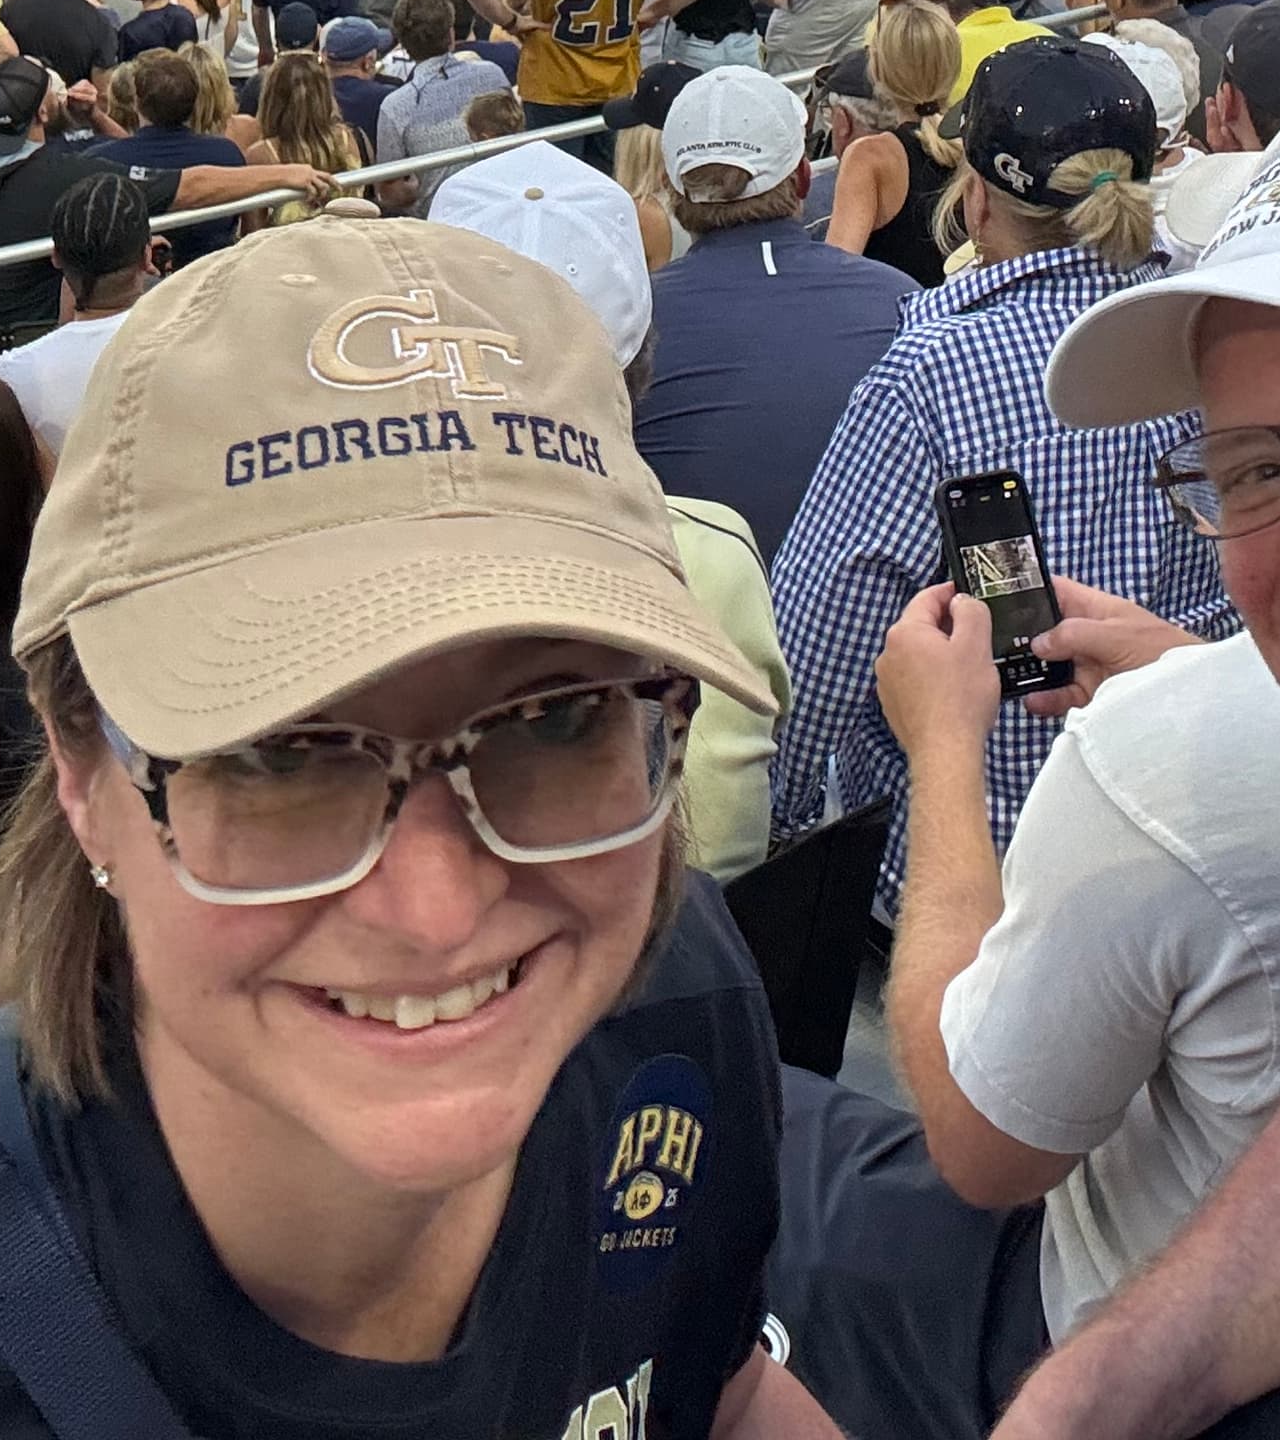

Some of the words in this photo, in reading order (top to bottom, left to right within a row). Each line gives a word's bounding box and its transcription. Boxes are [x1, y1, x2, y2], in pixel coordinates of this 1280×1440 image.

[676, 142, 706, 157] ATLANTA
[707, 141, 741, 149] ATHLETIC
[993, 151, 1034, 195] GT
[307, 288, 523, 400] GT
[224, 408, 476, 489] GEORGIA
[492, 411, 609, 478] TECH
[604, 1103, 703, 1190] APHI
